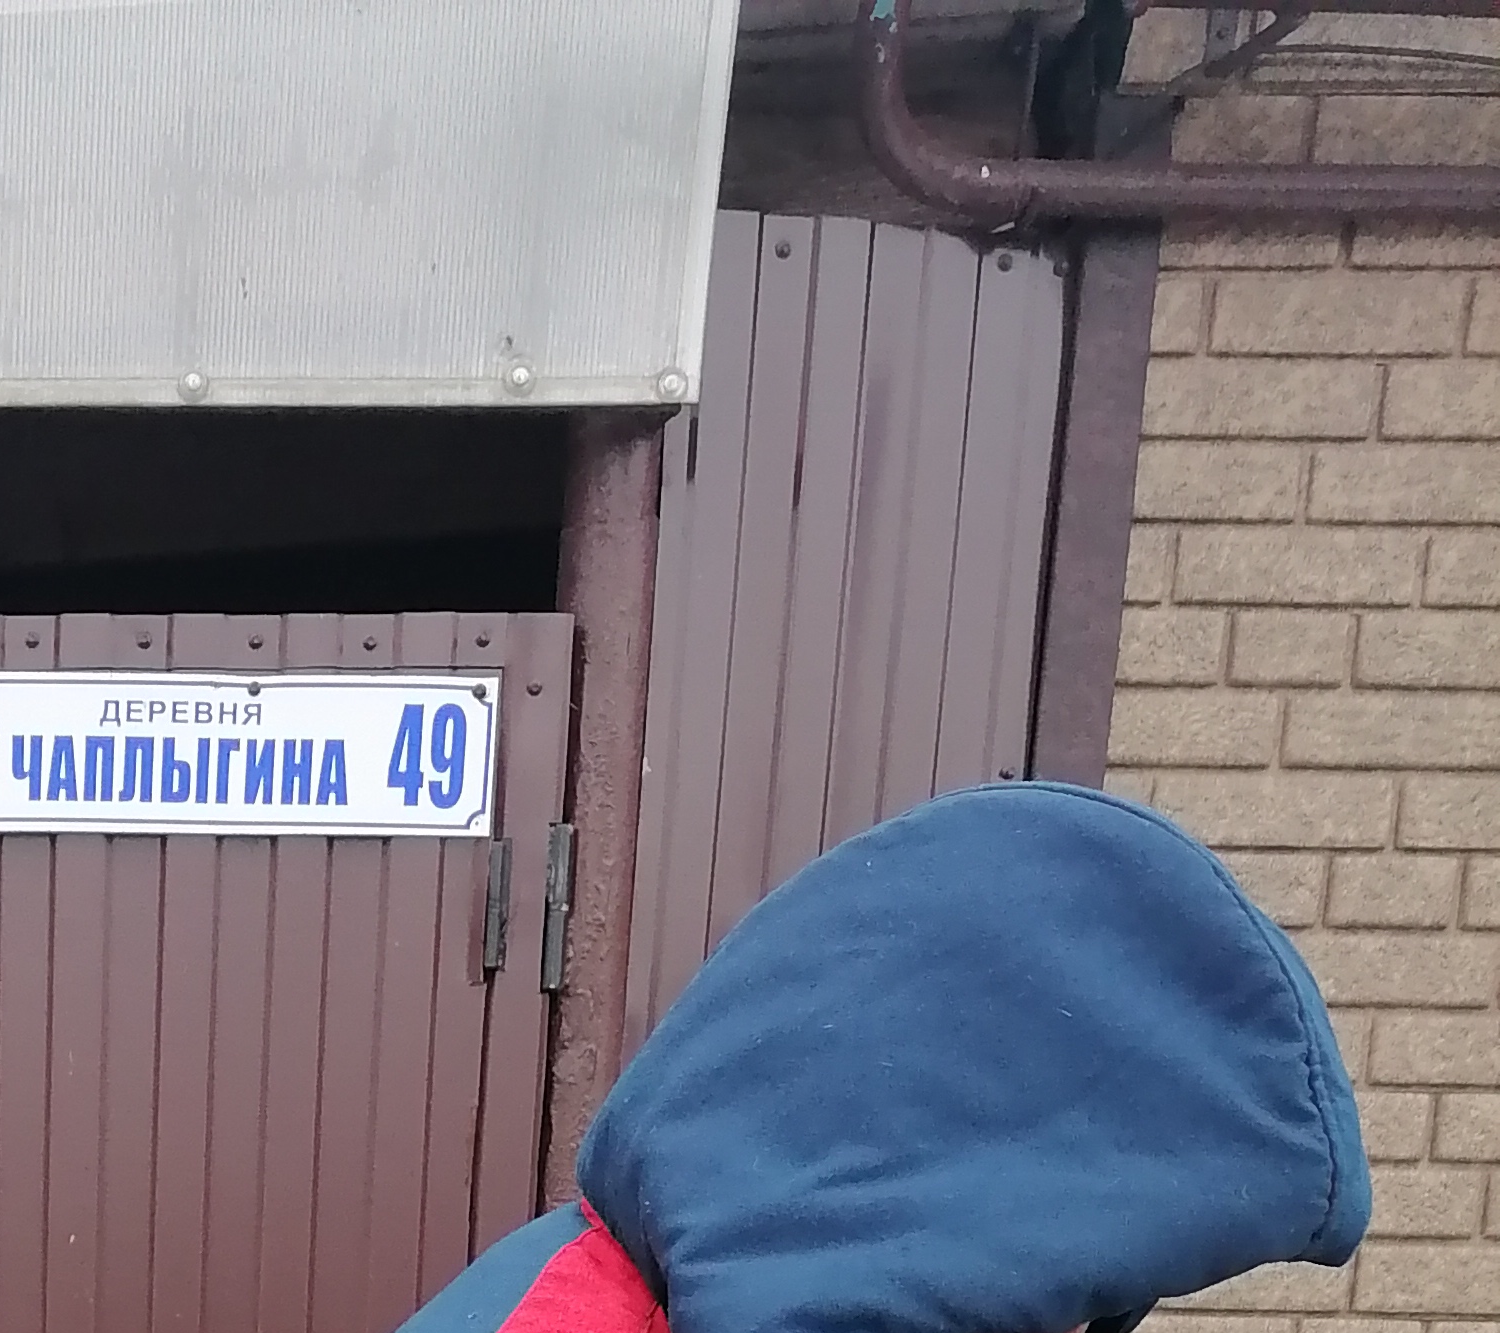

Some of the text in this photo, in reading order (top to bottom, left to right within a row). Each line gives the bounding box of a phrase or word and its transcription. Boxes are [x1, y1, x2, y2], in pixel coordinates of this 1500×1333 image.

[100, 699, 263, 727] ДЕРЕВНЯ
[11, 734, 349, 806] ЧАПЛЫГИНА
[386, 703, 469, 809] 49
